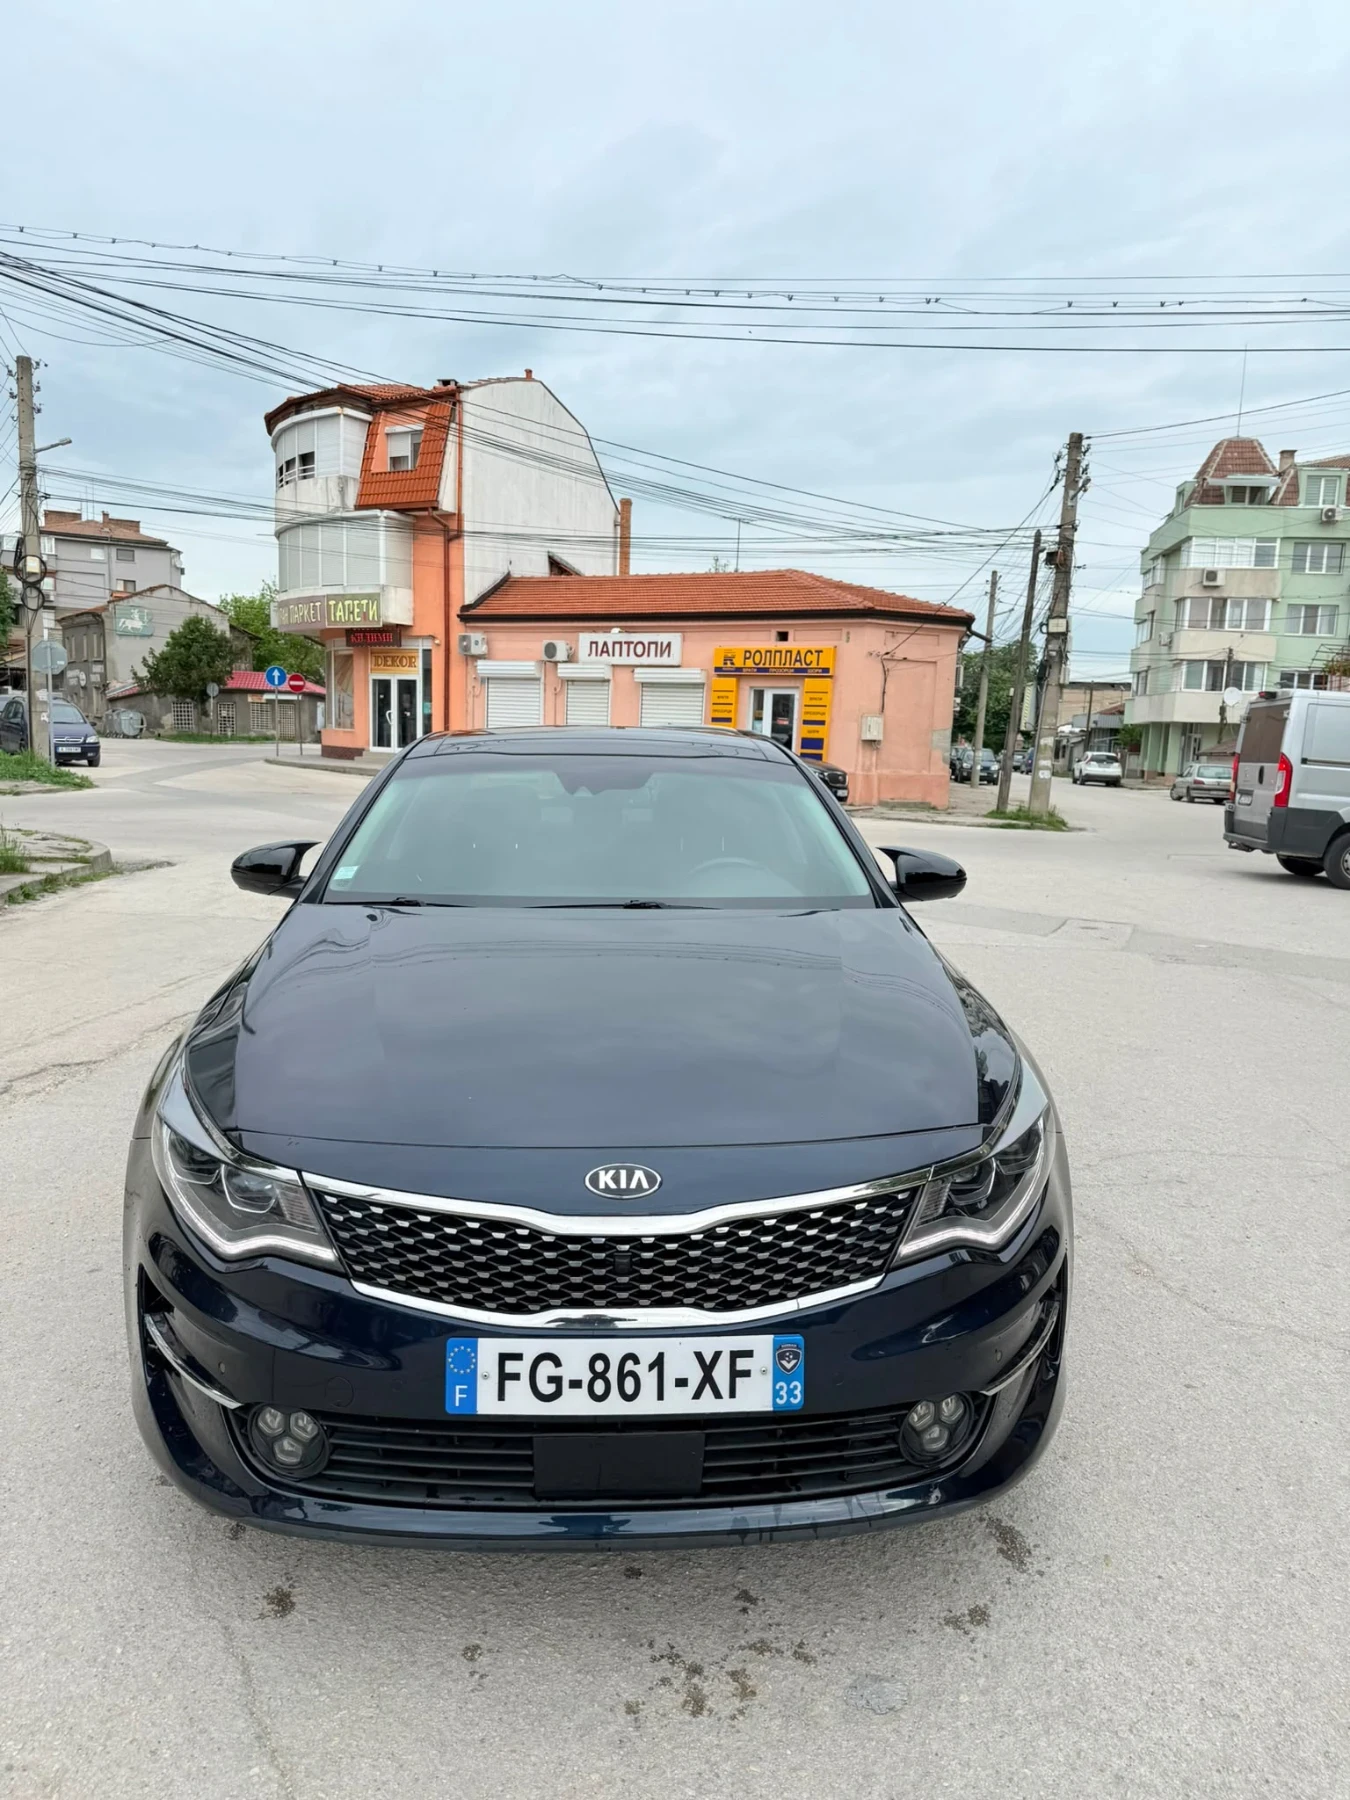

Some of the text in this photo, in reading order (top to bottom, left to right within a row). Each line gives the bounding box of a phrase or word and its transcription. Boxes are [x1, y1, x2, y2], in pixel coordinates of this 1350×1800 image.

[289, 601, 321, 624] ПАРКЕТ
[328, 599, 378, 622] ТАПЕТИ
[587, 640, 671, 658] ЛАПТОПИ
[743, 649, 823, 666] РОЛПЛАСТ
[373, 655, 417, 668] DEKOR
[598, 1169, 649, 1189] KIA
[455, 1349, 802, 1407] F FG-861-XF 33
